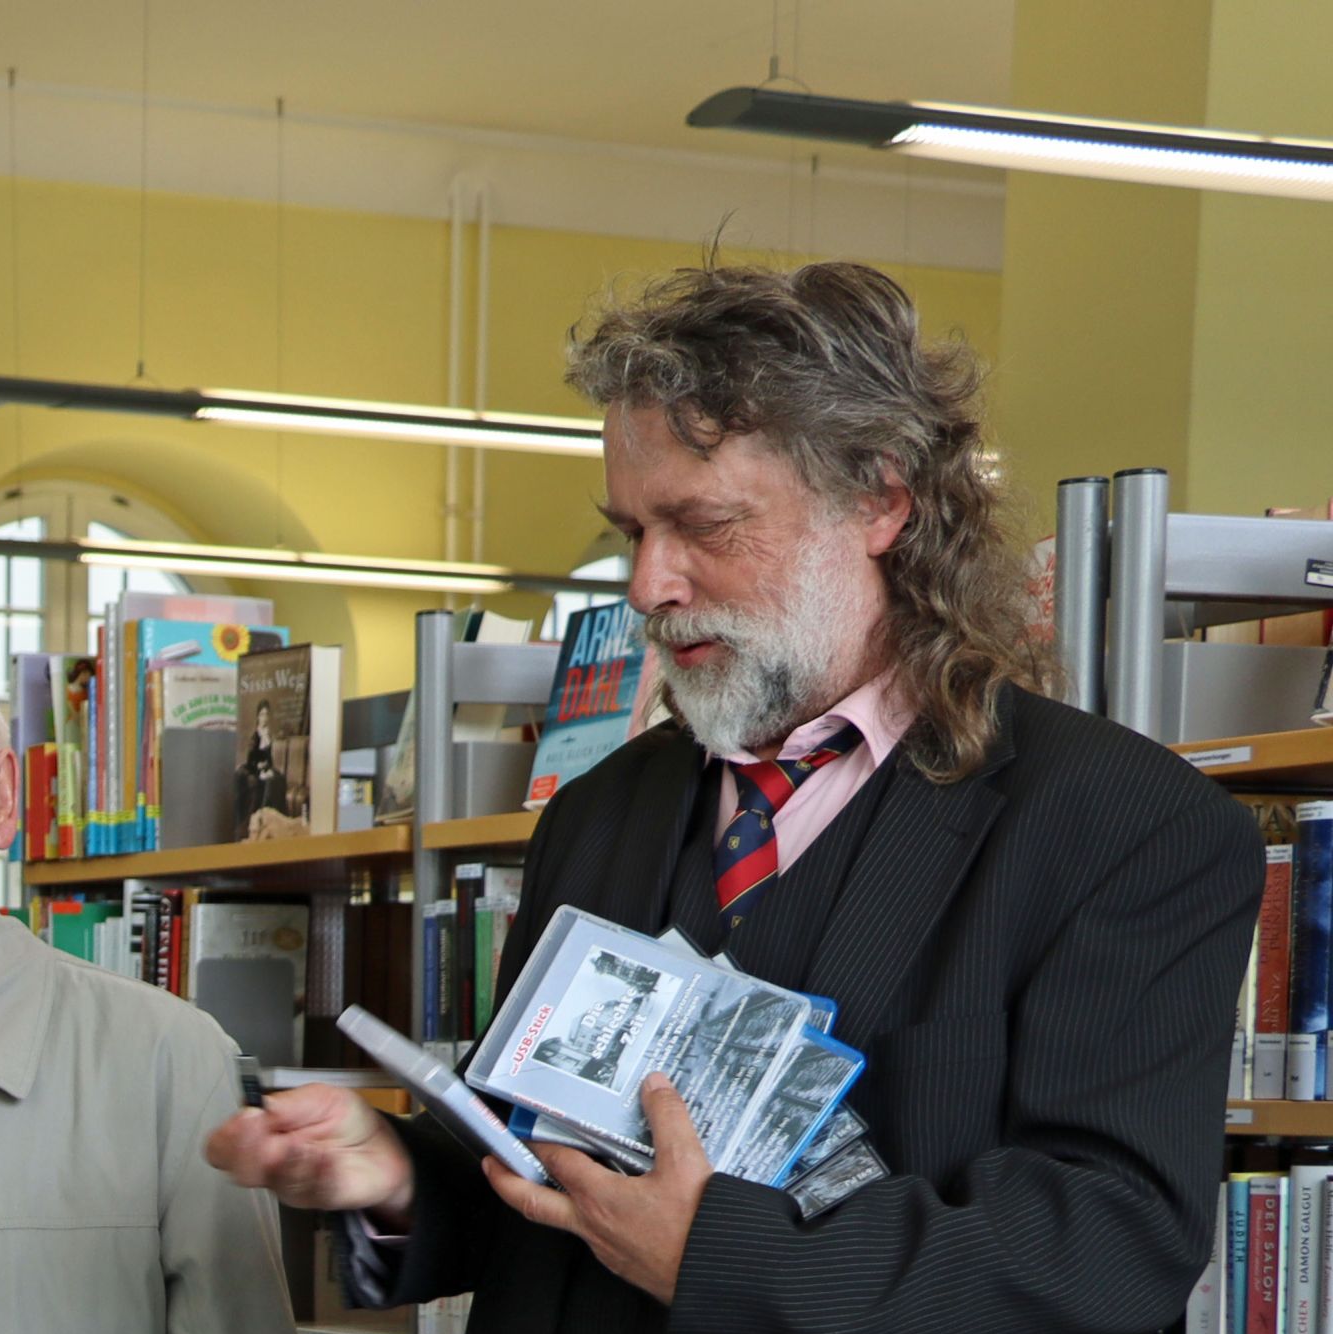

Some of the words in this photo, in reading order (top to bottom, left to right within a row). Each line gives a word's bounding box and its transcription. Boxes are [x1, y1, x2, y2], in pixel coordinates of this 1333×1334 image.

[569, 602, 633, 667] ARNE
[275, 668, 307, 693] Weg
[557, 657, 626, 723] DAHL
[513, 1004, 552, 1063] USB-Stick
[580, 1000, 606, 1029] Die
[589, 985, 639, 1060] schlechte
[619, 1012, 649, 1047] Zeit
[1263, 1197, 1276, 1232] DER
[1299, 1185, 1313, 1234] GALGUT
[1235, 1210, 1247, 1263] JUDITH
[1299, 1237, 1311, 1284] DAMON
[1262, 1241, 1276, 1303] SALON
[1198, 1310, 1210, 1331] LEE
